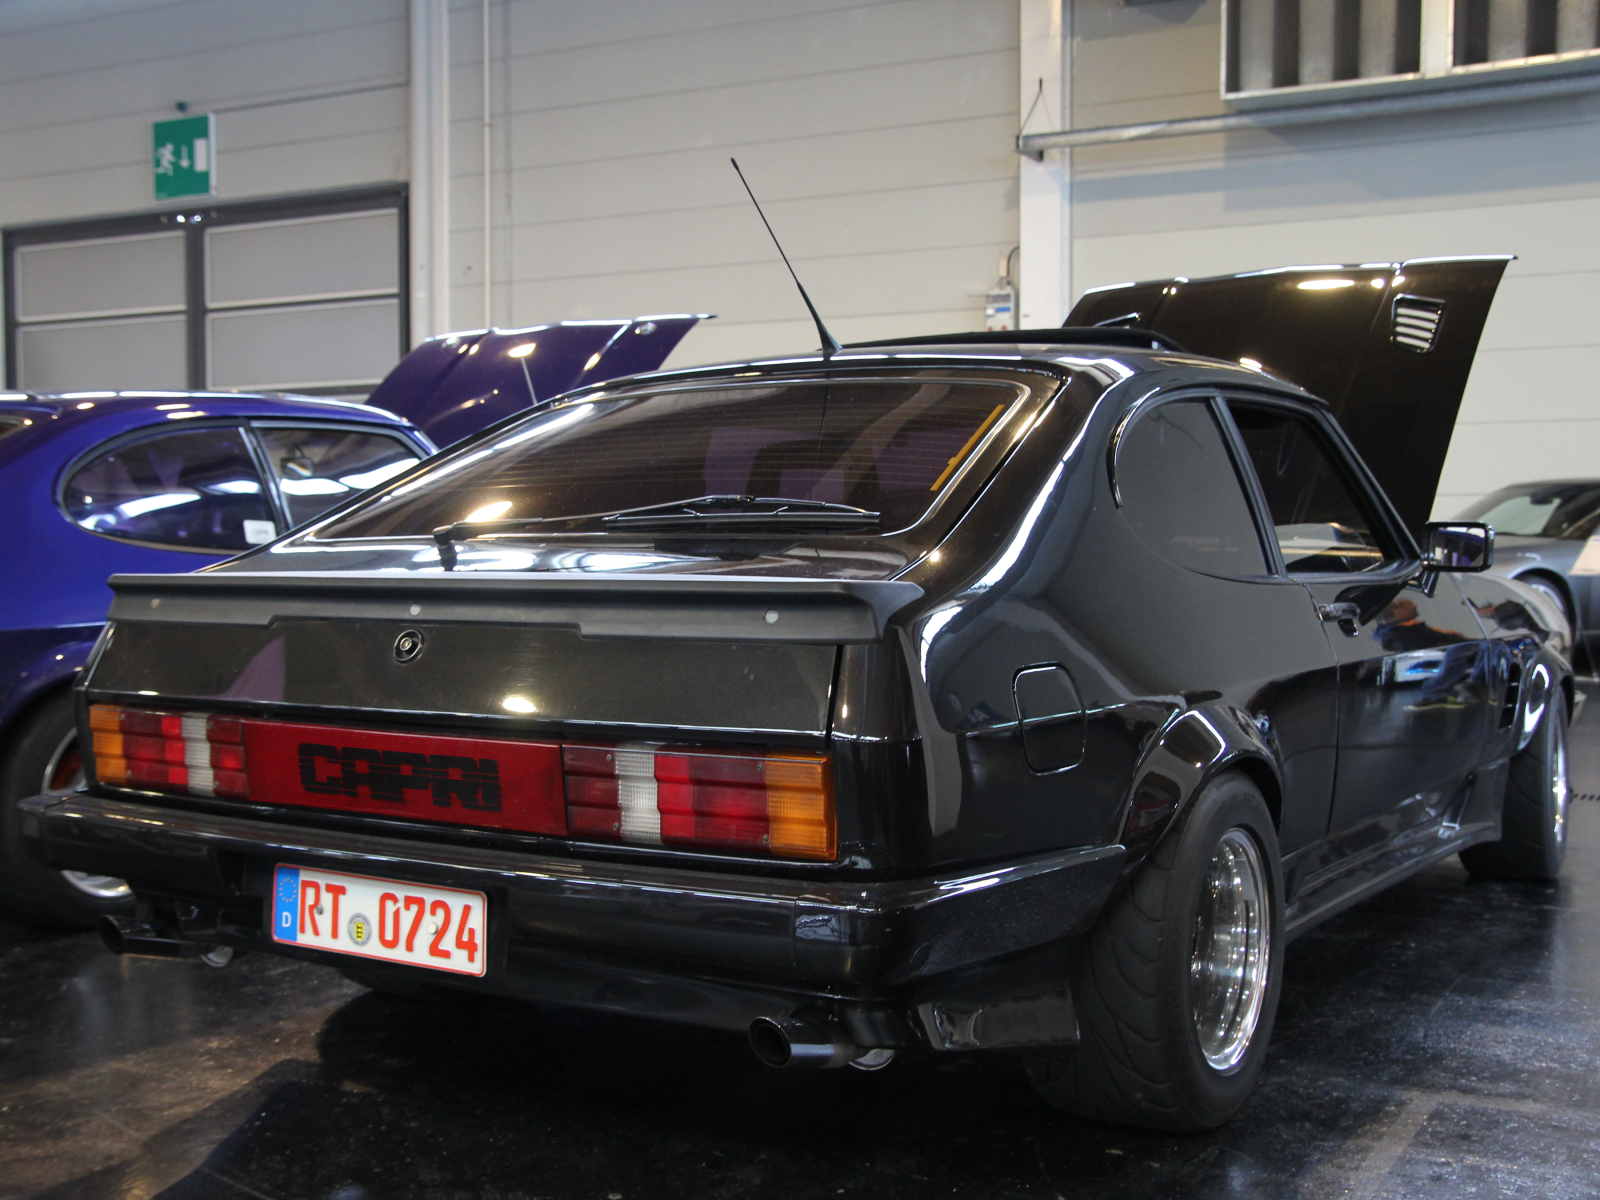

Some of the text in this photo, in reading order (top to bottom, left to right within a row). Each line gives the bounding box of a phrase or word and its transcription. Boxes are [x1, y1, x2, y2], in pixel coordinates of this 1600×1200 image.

[298, 743, 502, 812] CAPRI
[282, 912, 292, 928] D
[299, 880, 346, 939] RT
[379, 892, 478, 963] 0724
